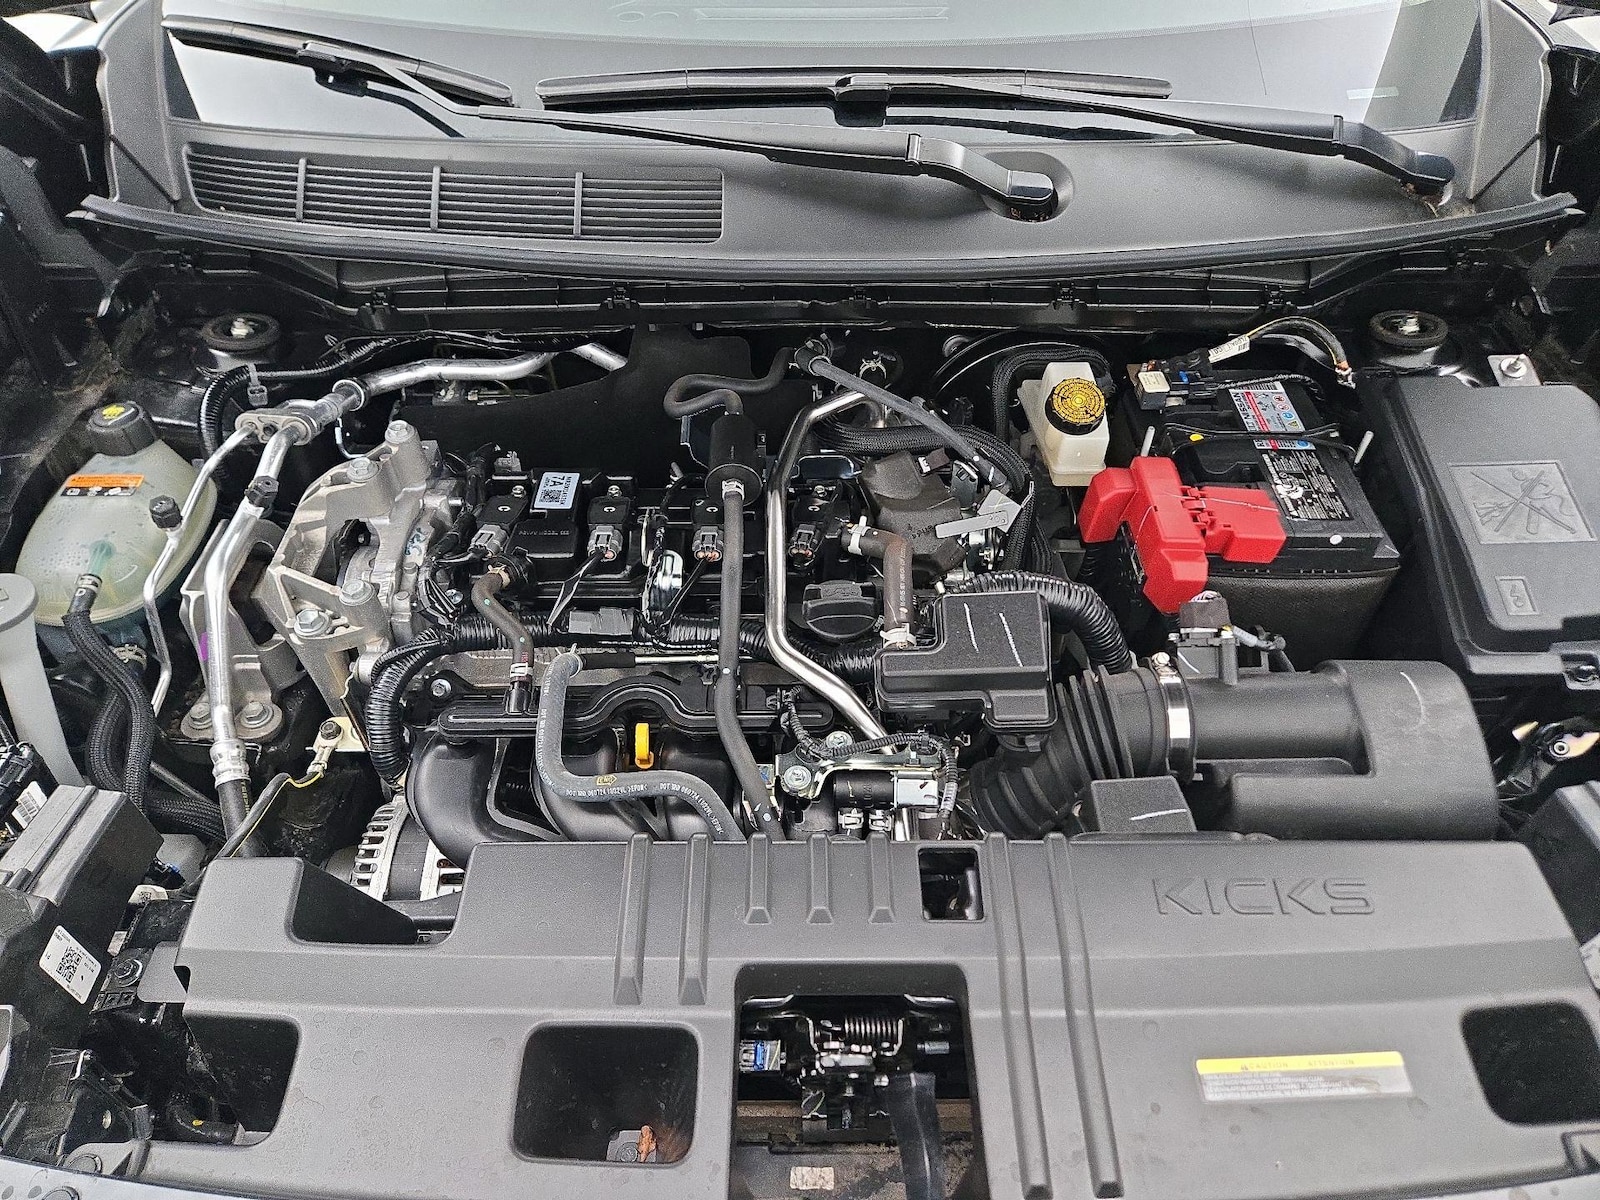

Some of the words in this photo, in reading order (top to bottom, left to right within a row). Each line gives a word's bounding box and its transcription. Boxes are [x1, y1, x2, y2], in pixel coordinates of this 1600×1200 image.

[1232, 392, 1251, 420] NISSAN
[550, 476, 565, 487] 7A
[75, 588, 86, 597] D
[1152, 878, 1374, 915] KICKS
[1249, 1062, 1288, 1070] CAUTION
[1308, 1059, 1355, 1067] ATTENTION
